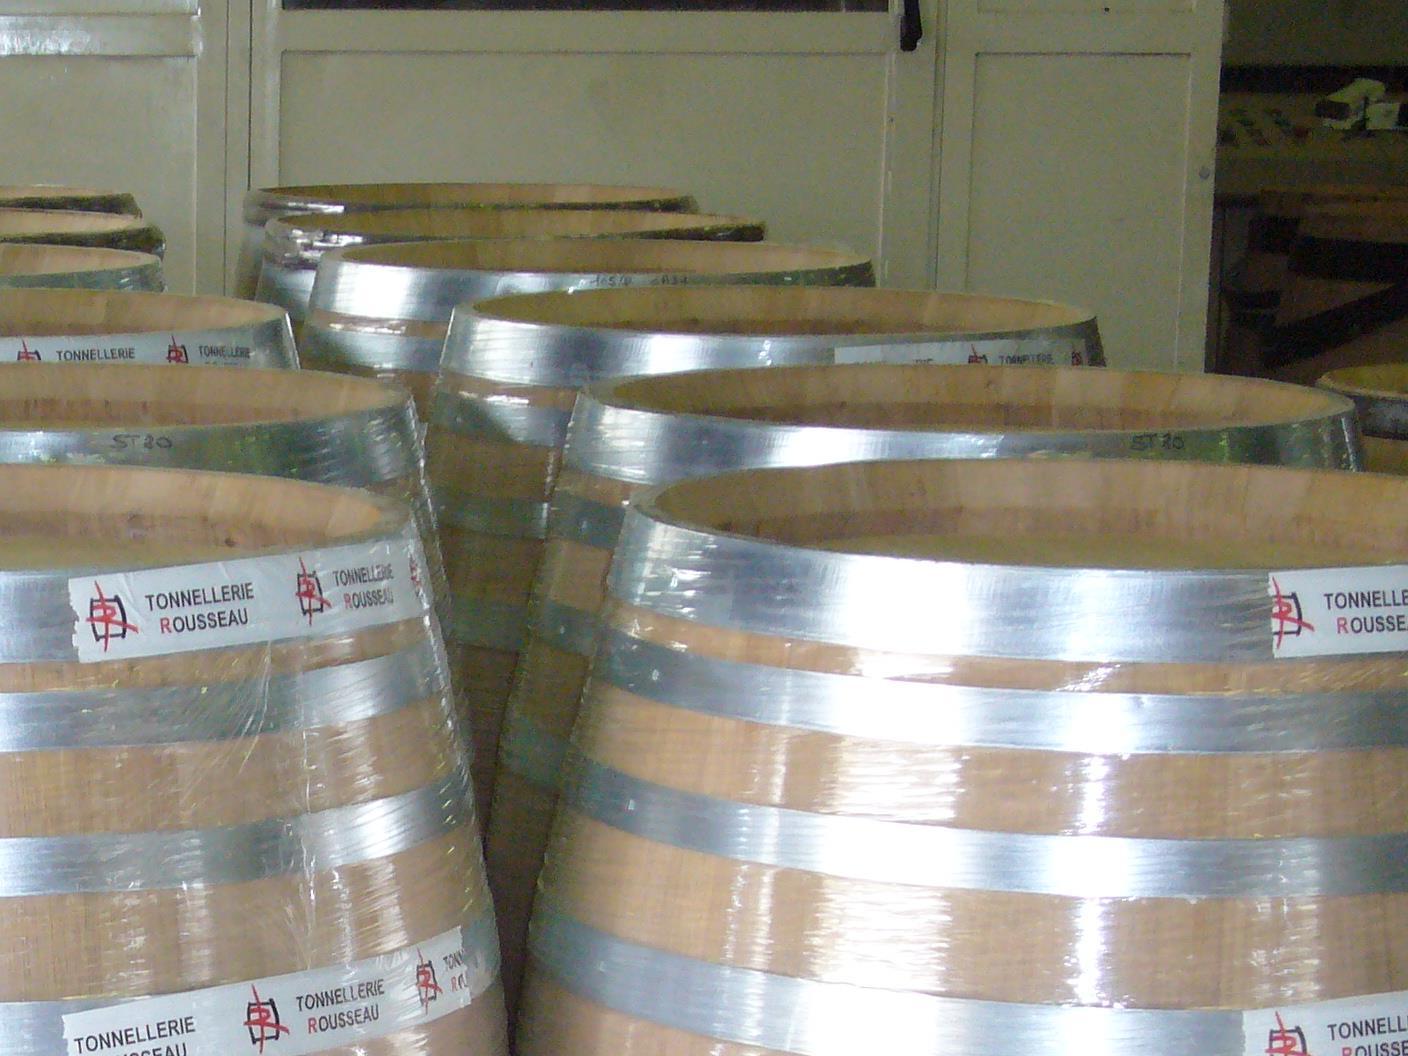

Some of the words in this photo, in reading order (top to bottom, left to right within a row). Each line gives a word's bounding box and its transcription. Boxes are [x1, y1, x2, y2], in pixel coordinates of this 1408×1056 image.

[56, 347, 136, 361] TONNELLERIE
[333, 563, 394, 588] TONNELLERIE
[144, 582, 255, 611] TONNELLERIE
[160, 607, 249, 634] ROUSSEAU
[1336, 614, 1408, 635] ROUSSE
[295, 978, 386, 1012] TONNELLERIE
[307, 1004, 381, 1035] ROUSSEAU
[1327, 1014, 1408, 1041] TONNELL
[73, 1015, 197, 1055] TONNELLERIE
